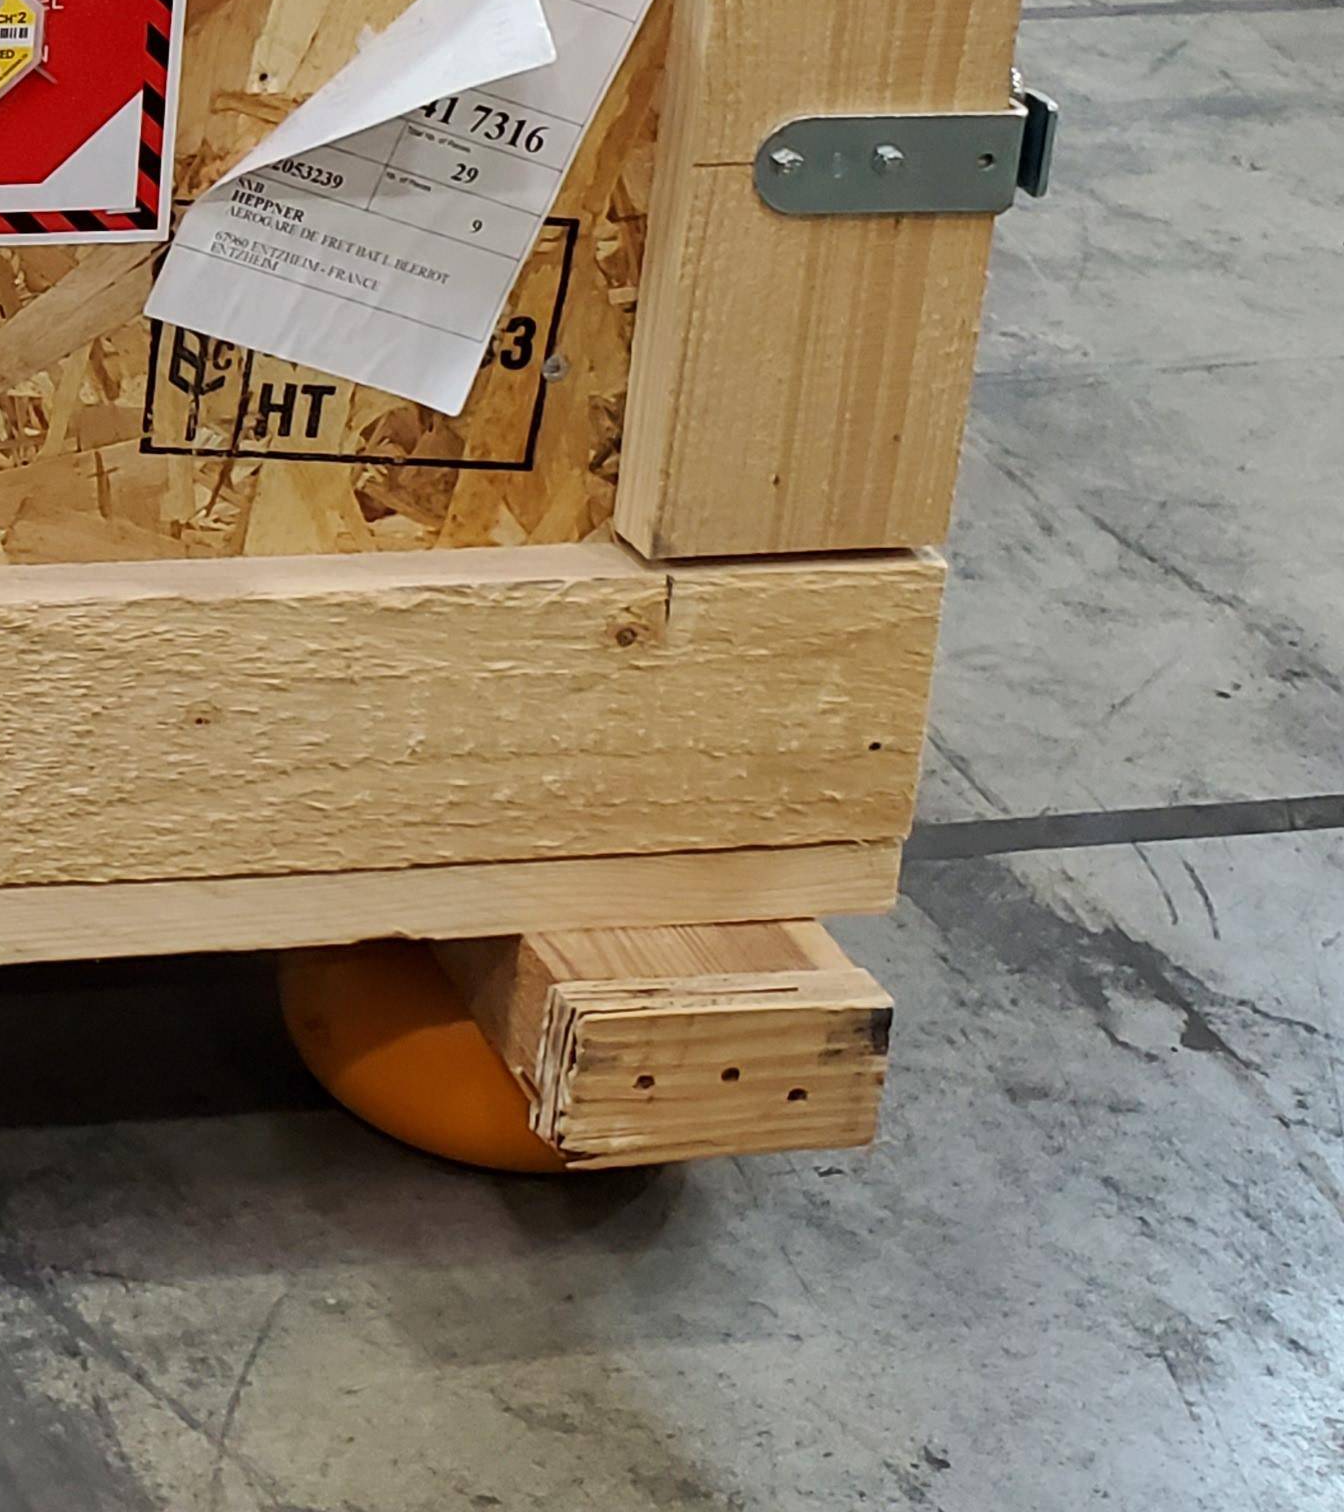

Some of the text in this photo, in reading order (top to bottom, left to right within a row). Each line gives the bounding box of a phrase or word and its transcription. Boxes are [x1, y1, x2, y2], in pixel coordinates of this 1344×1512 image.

[17, 12, 27, 24] 2
[470, 104, 551, 153] 7316
[450, 162, 480, 184] 29
[231, 190, 305, 223] HEPPNER
[471, 219, 483, 234] 9
[210, 240, 279, 272] ENTZHEIM
[320, 234, 355, 254] FRET
[250, 241, 321, 273] ENTZHEIM
[327, 264, 380, 291] FRANCE
[255, 382, 336, 438] HT
